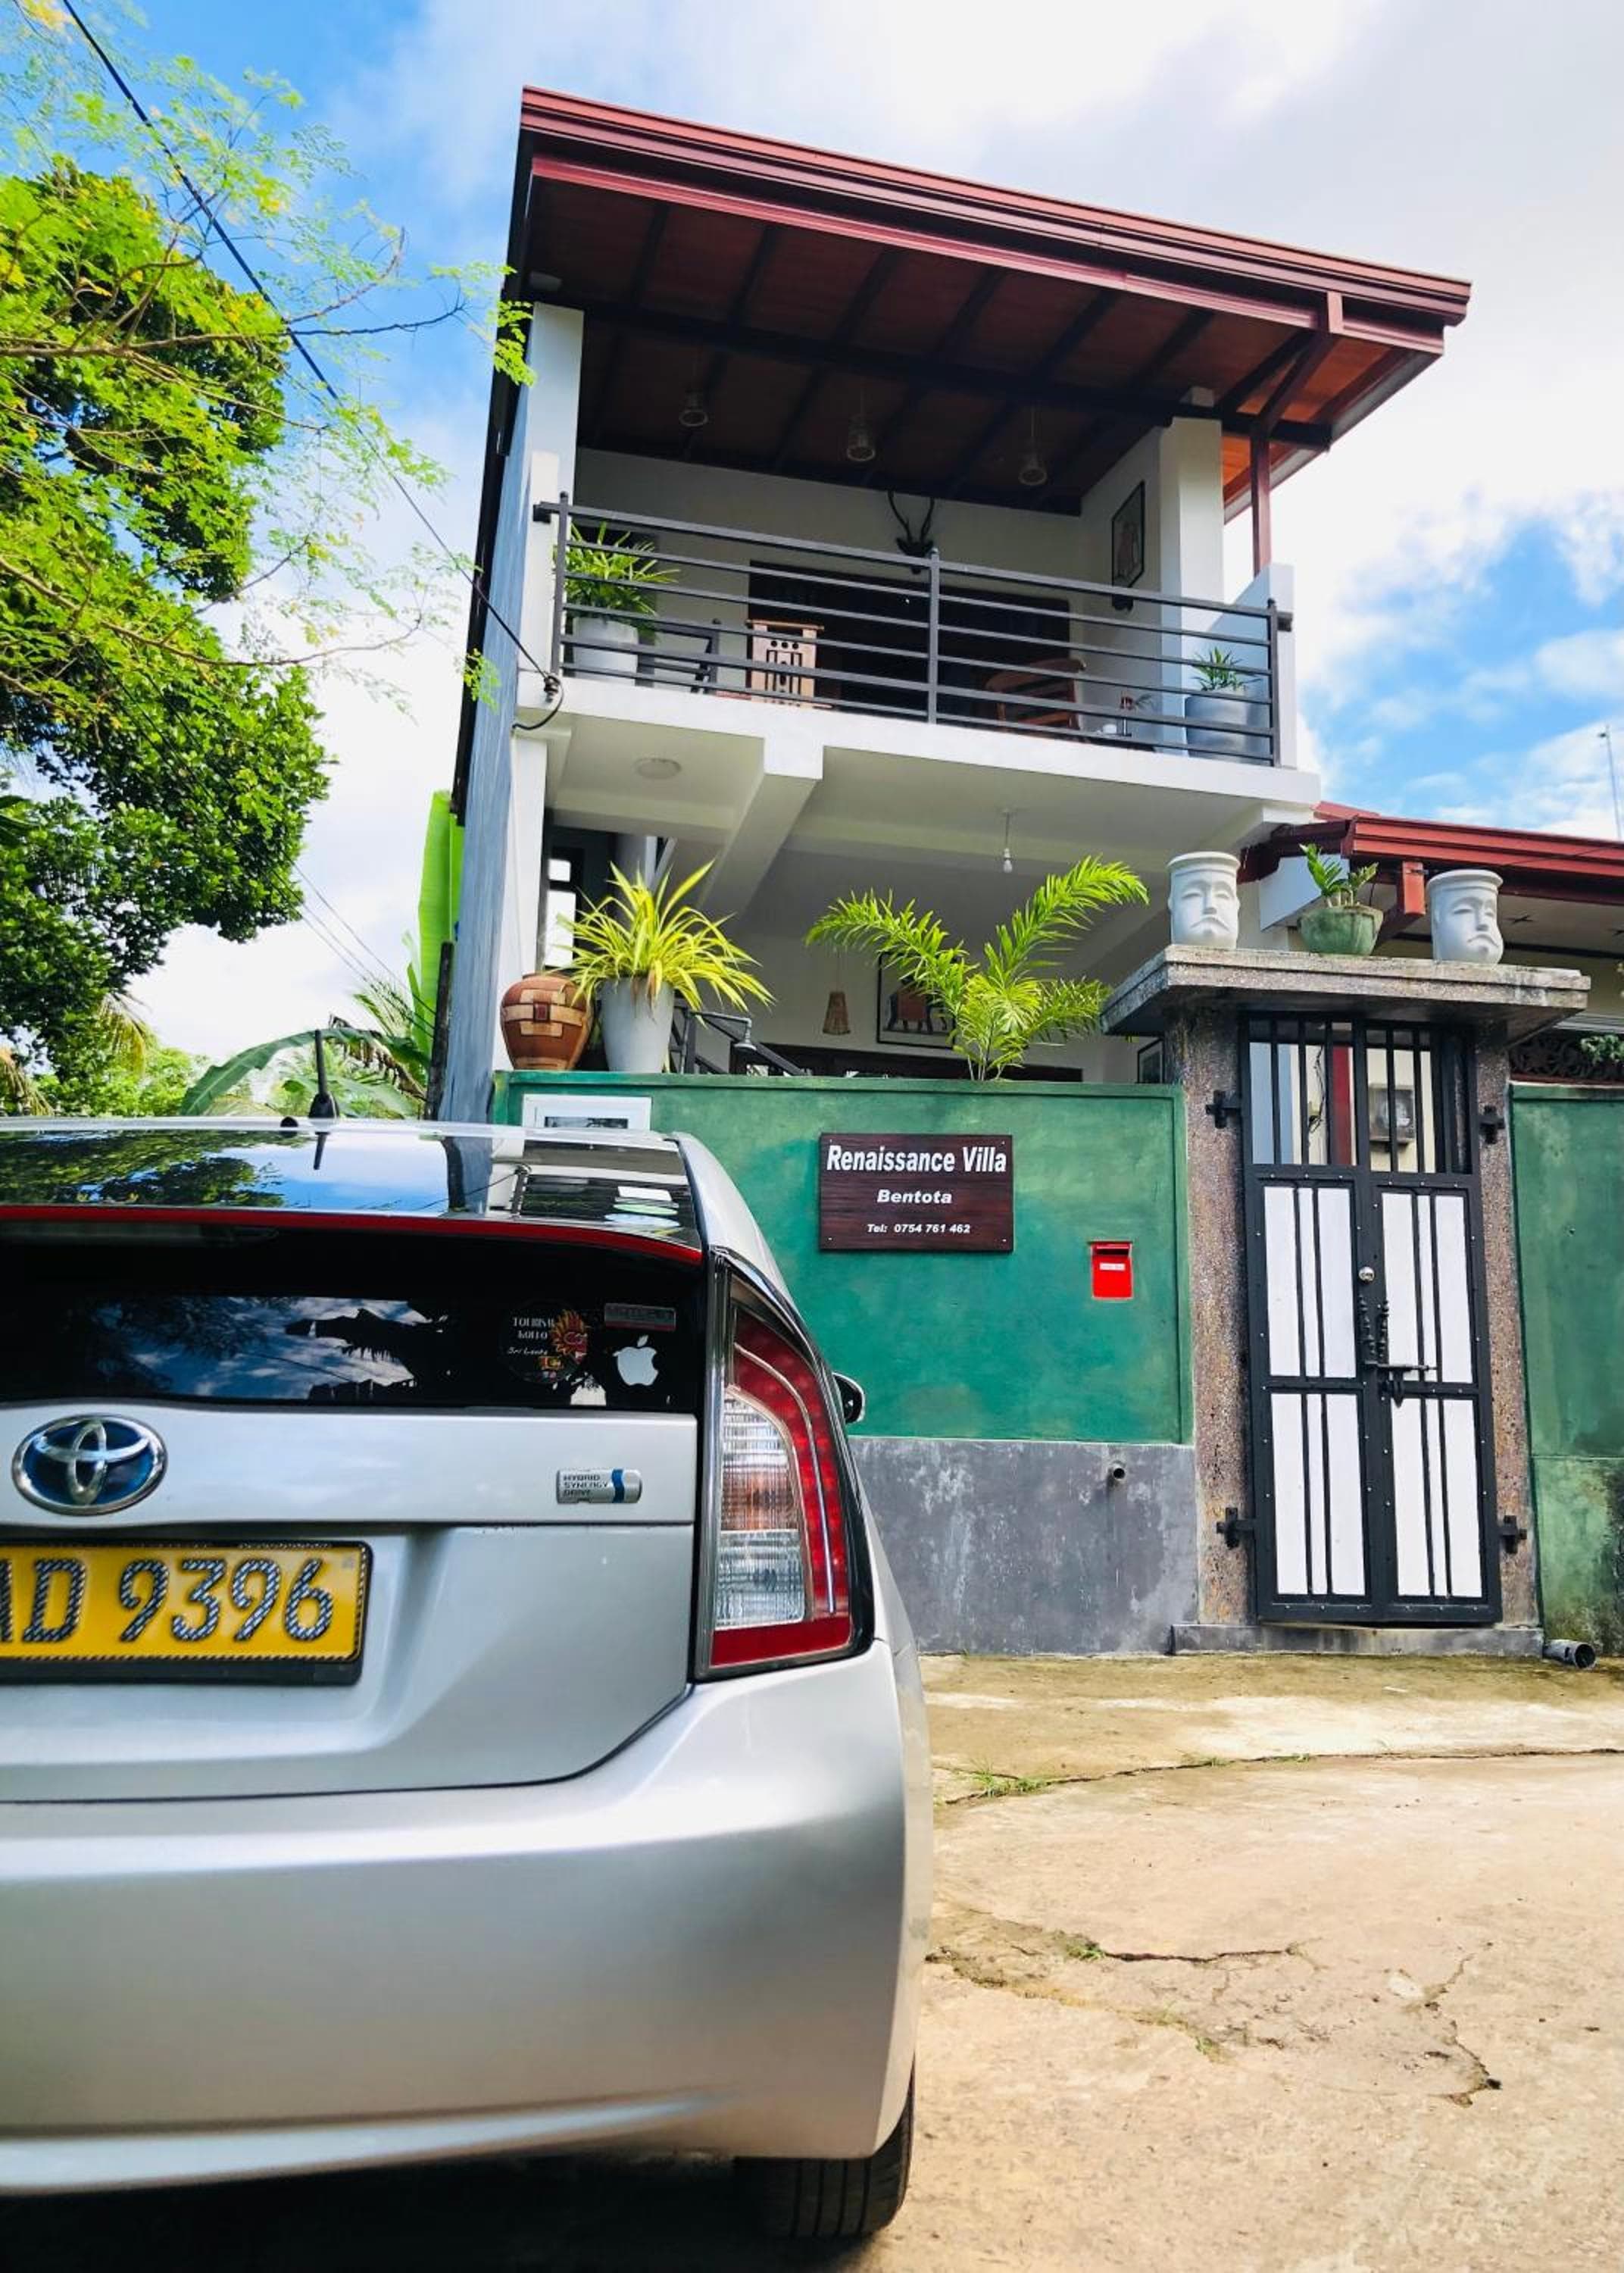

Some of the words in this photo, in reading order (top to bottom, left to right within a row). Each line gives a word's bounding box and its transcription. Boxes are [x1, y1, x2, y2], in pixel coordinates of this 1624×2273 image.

[826, 1145, 955, 1171] Renaissance
[963, 1146, 1007, 1172] Villa
[877, 1189, 952, 1204] Bentota
[867, 1224, 888, 1233] Tel:
[894, 1224, 922, 1233] 0754
[926, 1224, 946, 1233] 761
[949, 1224, 970, 1233] 462
[0, 1559, 86, 1643] D
[119, 1559, 334, 1643] 9396
